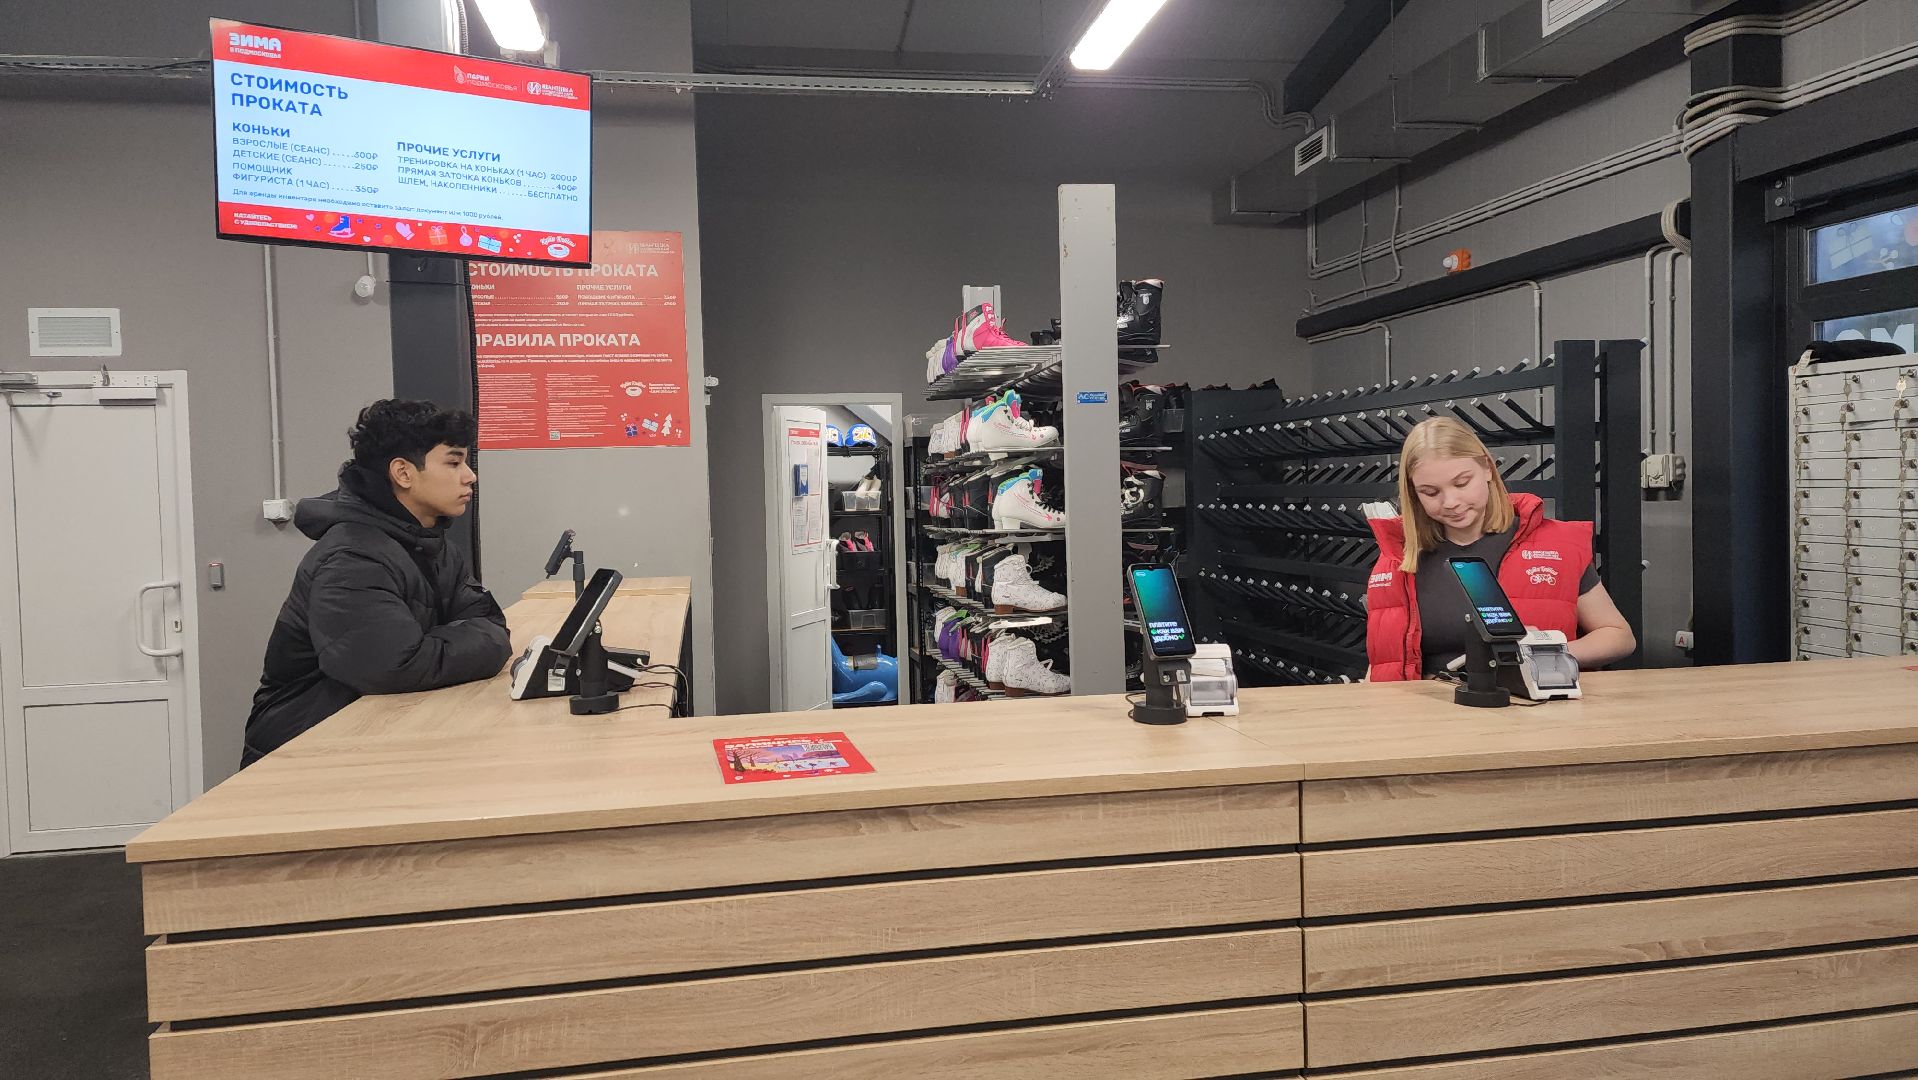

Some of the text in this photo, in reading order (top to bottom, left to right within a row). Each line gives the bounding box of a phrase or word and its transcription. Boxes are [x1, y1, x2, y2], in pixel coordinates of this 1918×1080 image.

[228, 32, 281, 51] ЗИМА
[231, 72, 348, 100] СТОИМОСТЬ
[232, 93, 323, 116] ПРОКАТА
[232, 122, 290, 138] КОНЬКИ
[232, 138, 288, 150] ВЗРОСЛЫЕ
[290, 144, 330, 156] (СЕАНС)
[397, 142, 501, 162] ПРОЧИЕ УСЛУГИ
[232, 150, 281, 161] ДЕТСКИЕ
[282, 154, 322, 166] (СЕАНС)
[397, 156, 458, 170] ТРЕНИРОВКА
[460, 163, 473, 171] НА
[474, 164, 514, 176] КОНЬКАХ
[232, 162, 293, 175] ПОМОЩНИК
[398, 166, 436, 178] ПРЯМАЯ
[438, 170, 480, 182] ЗАТОЧКА
[481, 176, 522, 187] КОНЬКОВ
[232, 173, 294, 186] ФИГУРИСТА
[527, 190, 578, 202] БЕСПЛАТНО
[560, 334, 640, 346] ПРОКАТА
